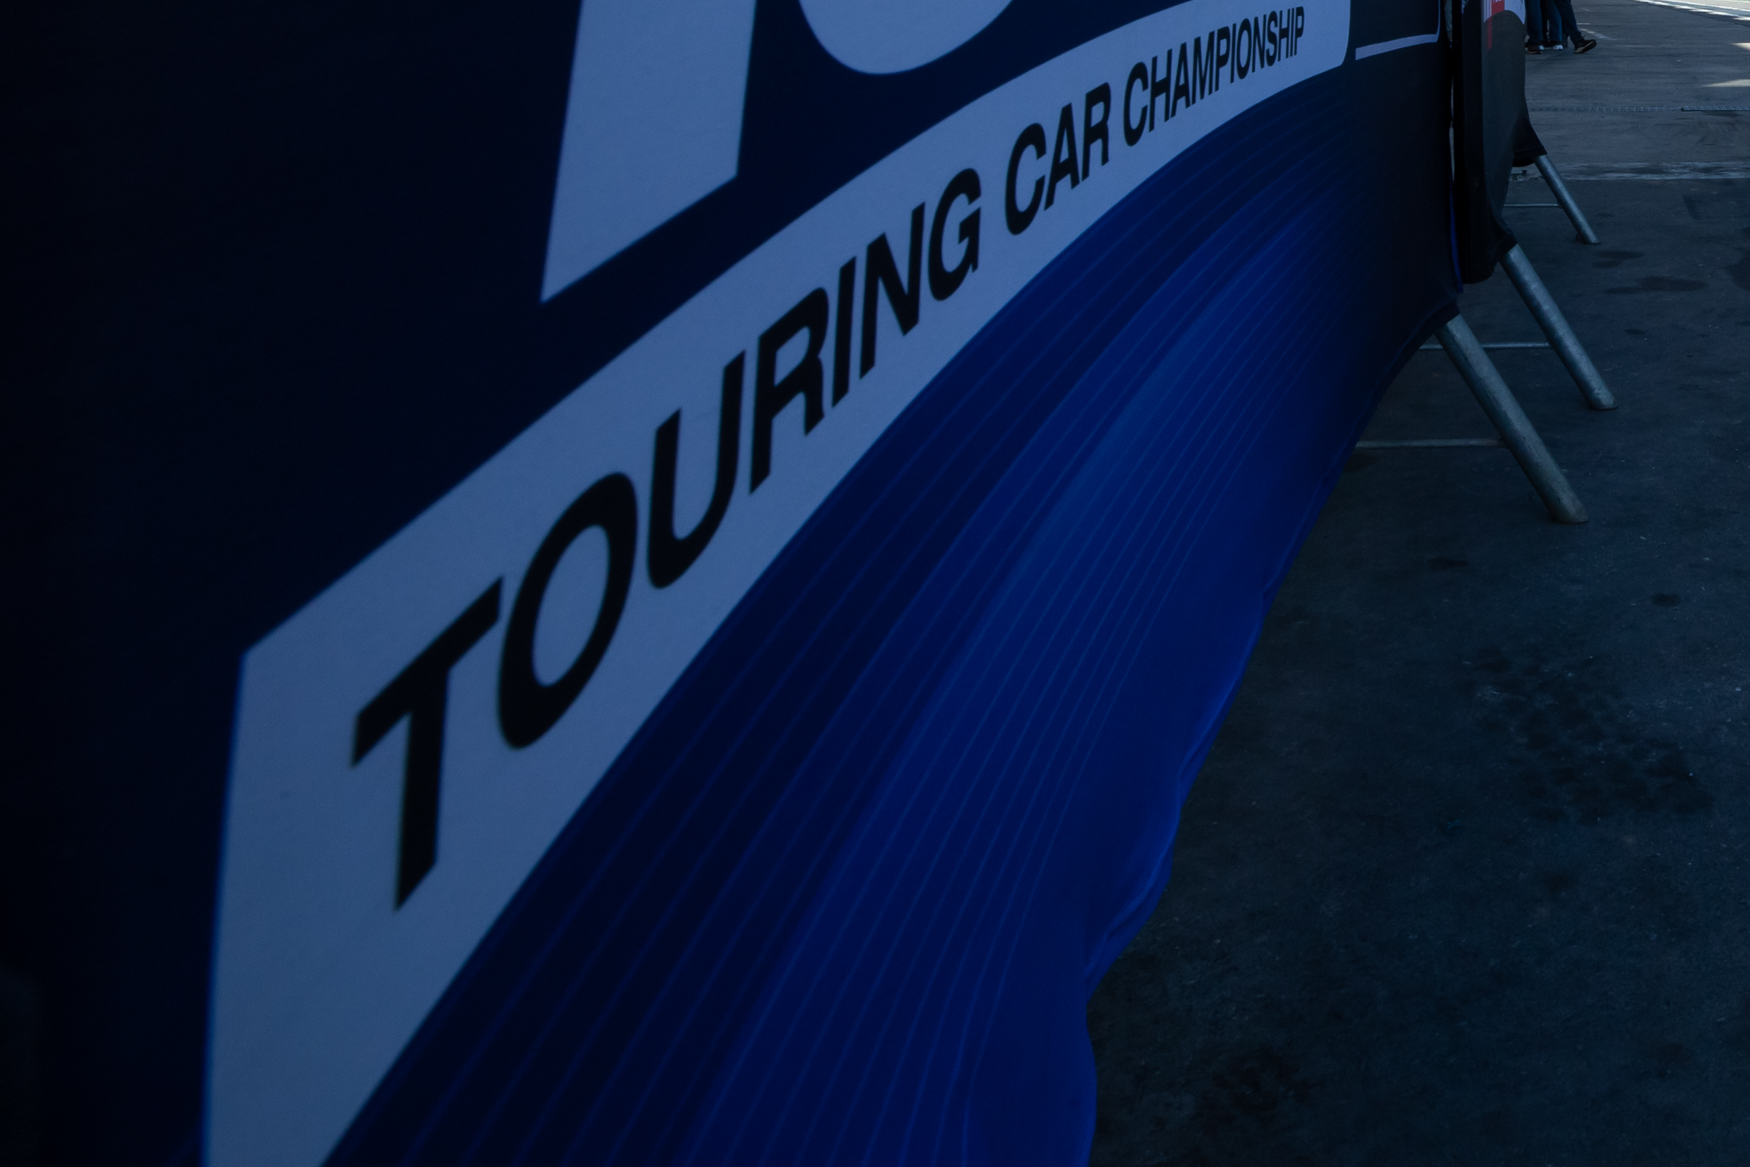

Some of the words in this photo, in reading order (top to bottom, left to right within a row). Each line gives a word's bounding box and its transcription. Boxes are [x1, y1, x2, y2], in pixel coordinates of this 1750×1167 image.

[350, 168, 983, 913] TOURING
[1005, 83, 1111, 234] CAR
[1123, 6, 1305, 146] CHAMPIONSHIP
